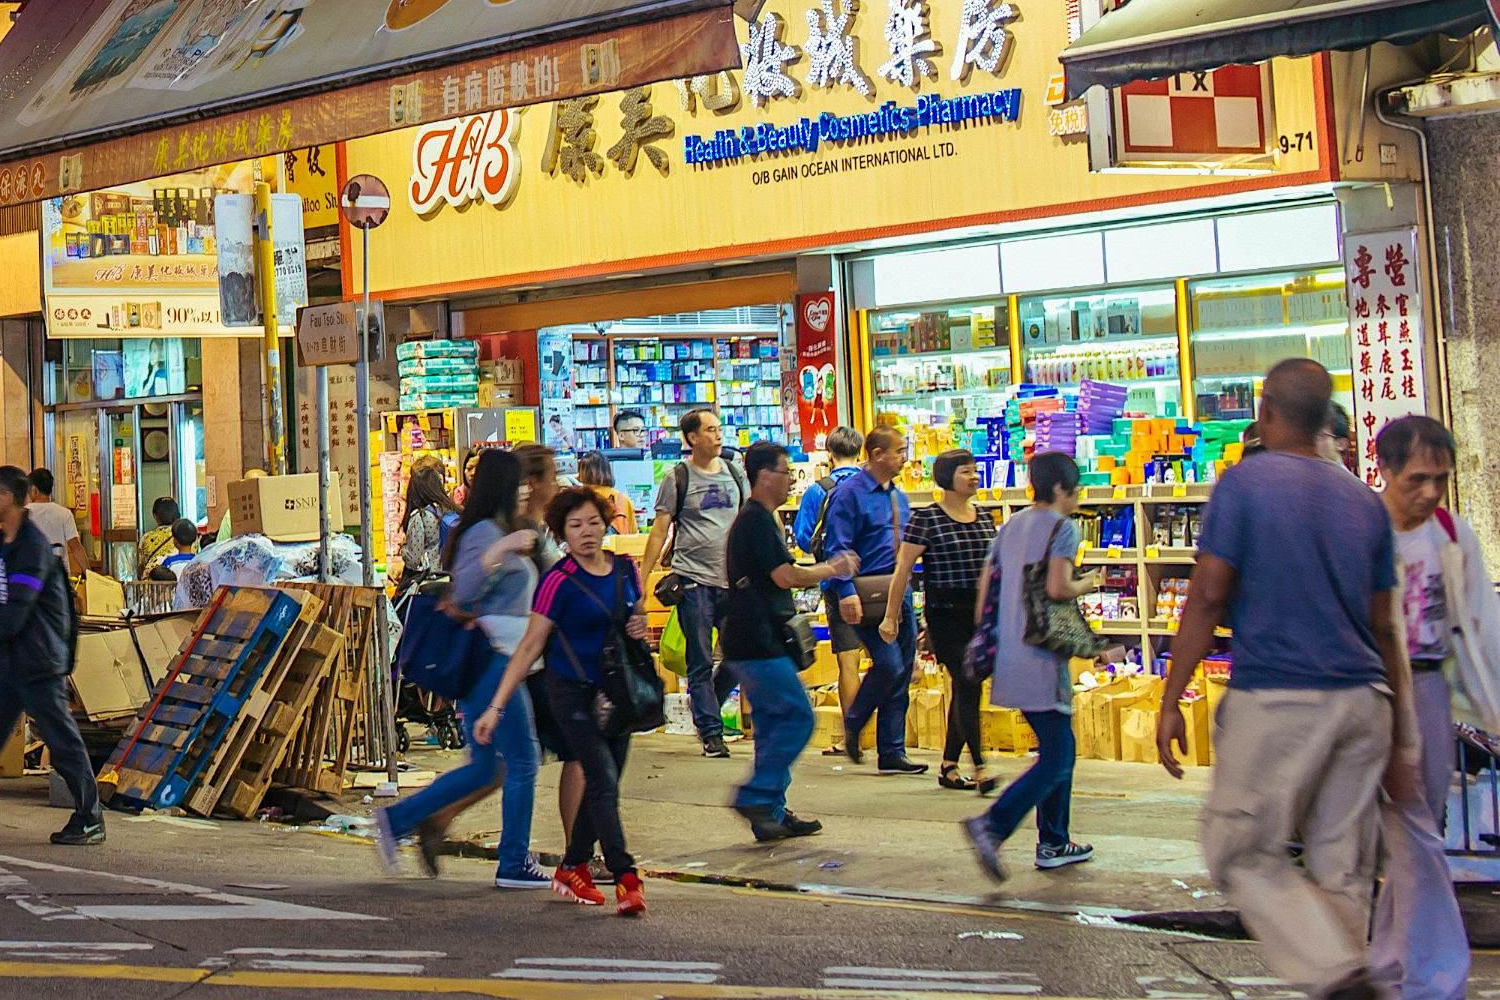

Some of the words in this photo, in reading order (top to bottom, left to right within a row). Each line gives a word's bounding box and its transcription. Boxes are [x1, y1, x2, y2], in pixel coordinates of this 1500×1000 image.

[684, 129, 736, 164] Health
[739, 126, 754, 155] &
[757, 116, 815, 152] Beauty
[818, 101, 911, 141] Cosmetics
[916, 88, 1016, 126] Pharmacy
[752, 170, 770, 185] O/B
[773, 166, 798, 183] GAIN
[801, 160, 838, 179] OCEAN
[841, 147, 930, 173] INTERNATIONAL
[933, 142, 958, 159] LTD.
[1352, 243, 1410, 290] 專營
[295, 496, 317, 508] SNP
